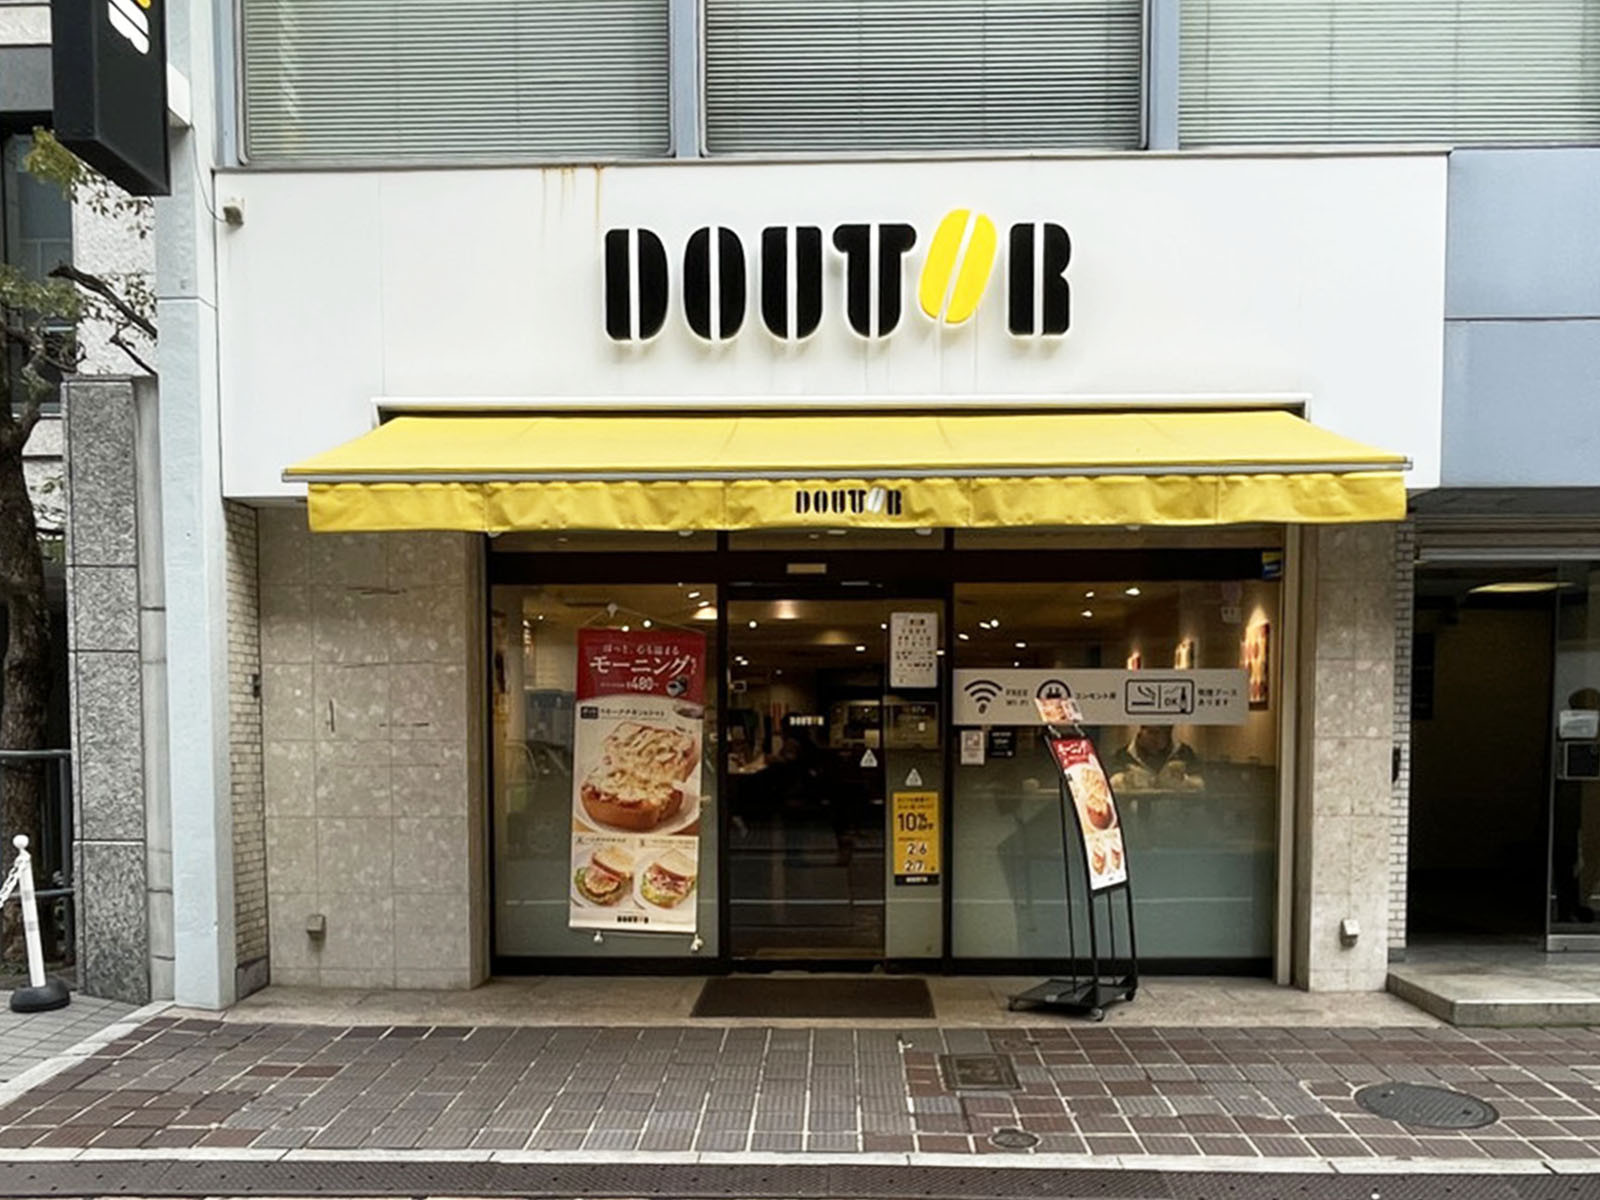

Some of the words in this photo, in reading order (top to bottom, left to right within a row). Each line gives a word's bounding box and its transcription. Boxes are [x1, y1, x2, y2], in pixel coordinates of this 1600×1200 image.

[605, 208, 1071, 340] DOUTOR
[795, 487, 902, 515] DOUTOR
[589, 655, 690, 677] モーニング
